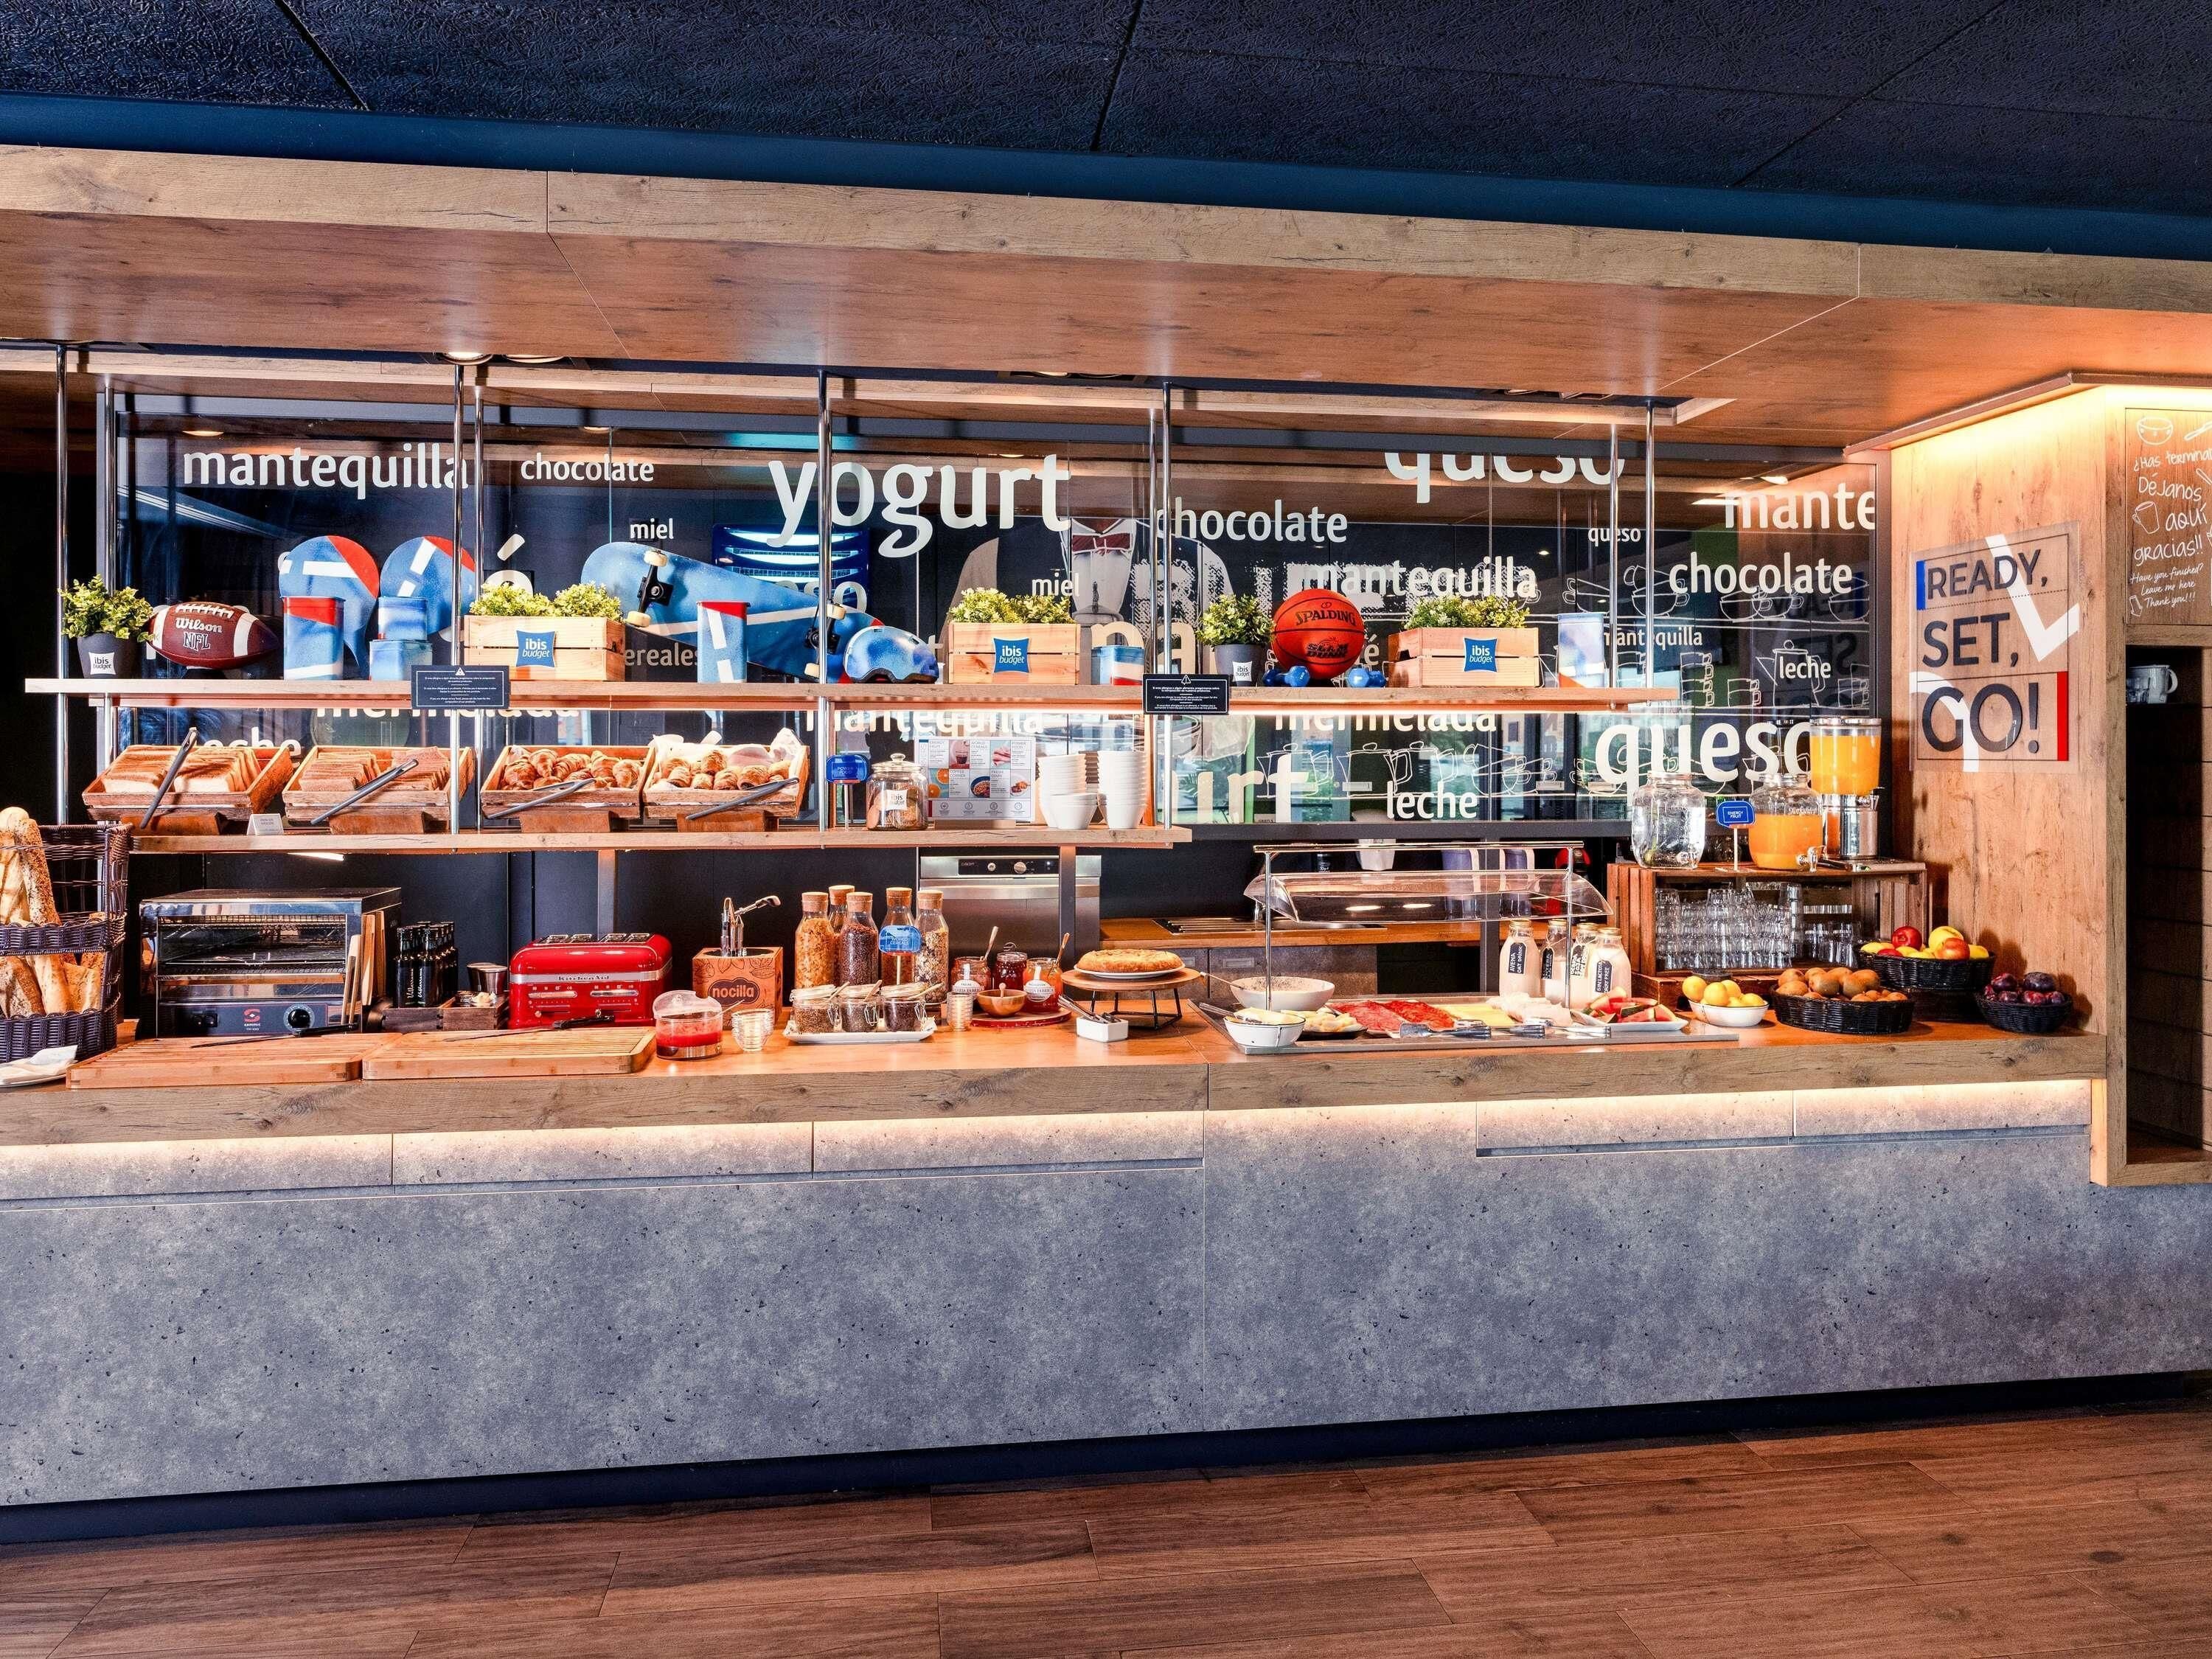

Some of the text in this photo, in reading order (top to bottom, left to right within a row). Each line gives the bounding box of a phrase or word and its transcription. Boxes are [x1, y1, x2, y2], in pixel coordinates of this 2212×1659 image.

[183, 442, 469, 500] mantequilla
[520, 452, 655, 482] chocolate
[766, 453, 1072, 558] yogurt
[630, 518, 674, 540] miel
[1669, 552, 1852, 594] chocolate
[1927, 549, 2048, 602] READY,
[2129, 571, 2154, 585] Have
[2154, 572, 2169, 584] you
[1032, 572, 1080, 598] miel
[2140, 580, 2196, 597] Leave me here
[2144, 596, 2171, 609] Thank
[175, 617, 223, 633] Wilson
[1295, 610, 1356, 627] SPALDING
[183, 631, 211, 652] NFL
[525, 638, 547, 650] ibis
[1921, 612, 2020, 669] SET,
[94, 656, 109, 664] ibis
[522, 649, 550, 659] budget
[625, 642, 698, 666] ereale
[999, 655, 1025, 665] budget
[1002, 645, 1022, 657] ibis
[1469, 655, 1493, 664] budget
[1472, 645, 1490, 656] ibis
[1779, 655, 1832, 679] leche
[1921, 681, 2040, 754] GO!
[1386, 780, 1478, 819] leche
[712, 984, 754, 998] nocilla
